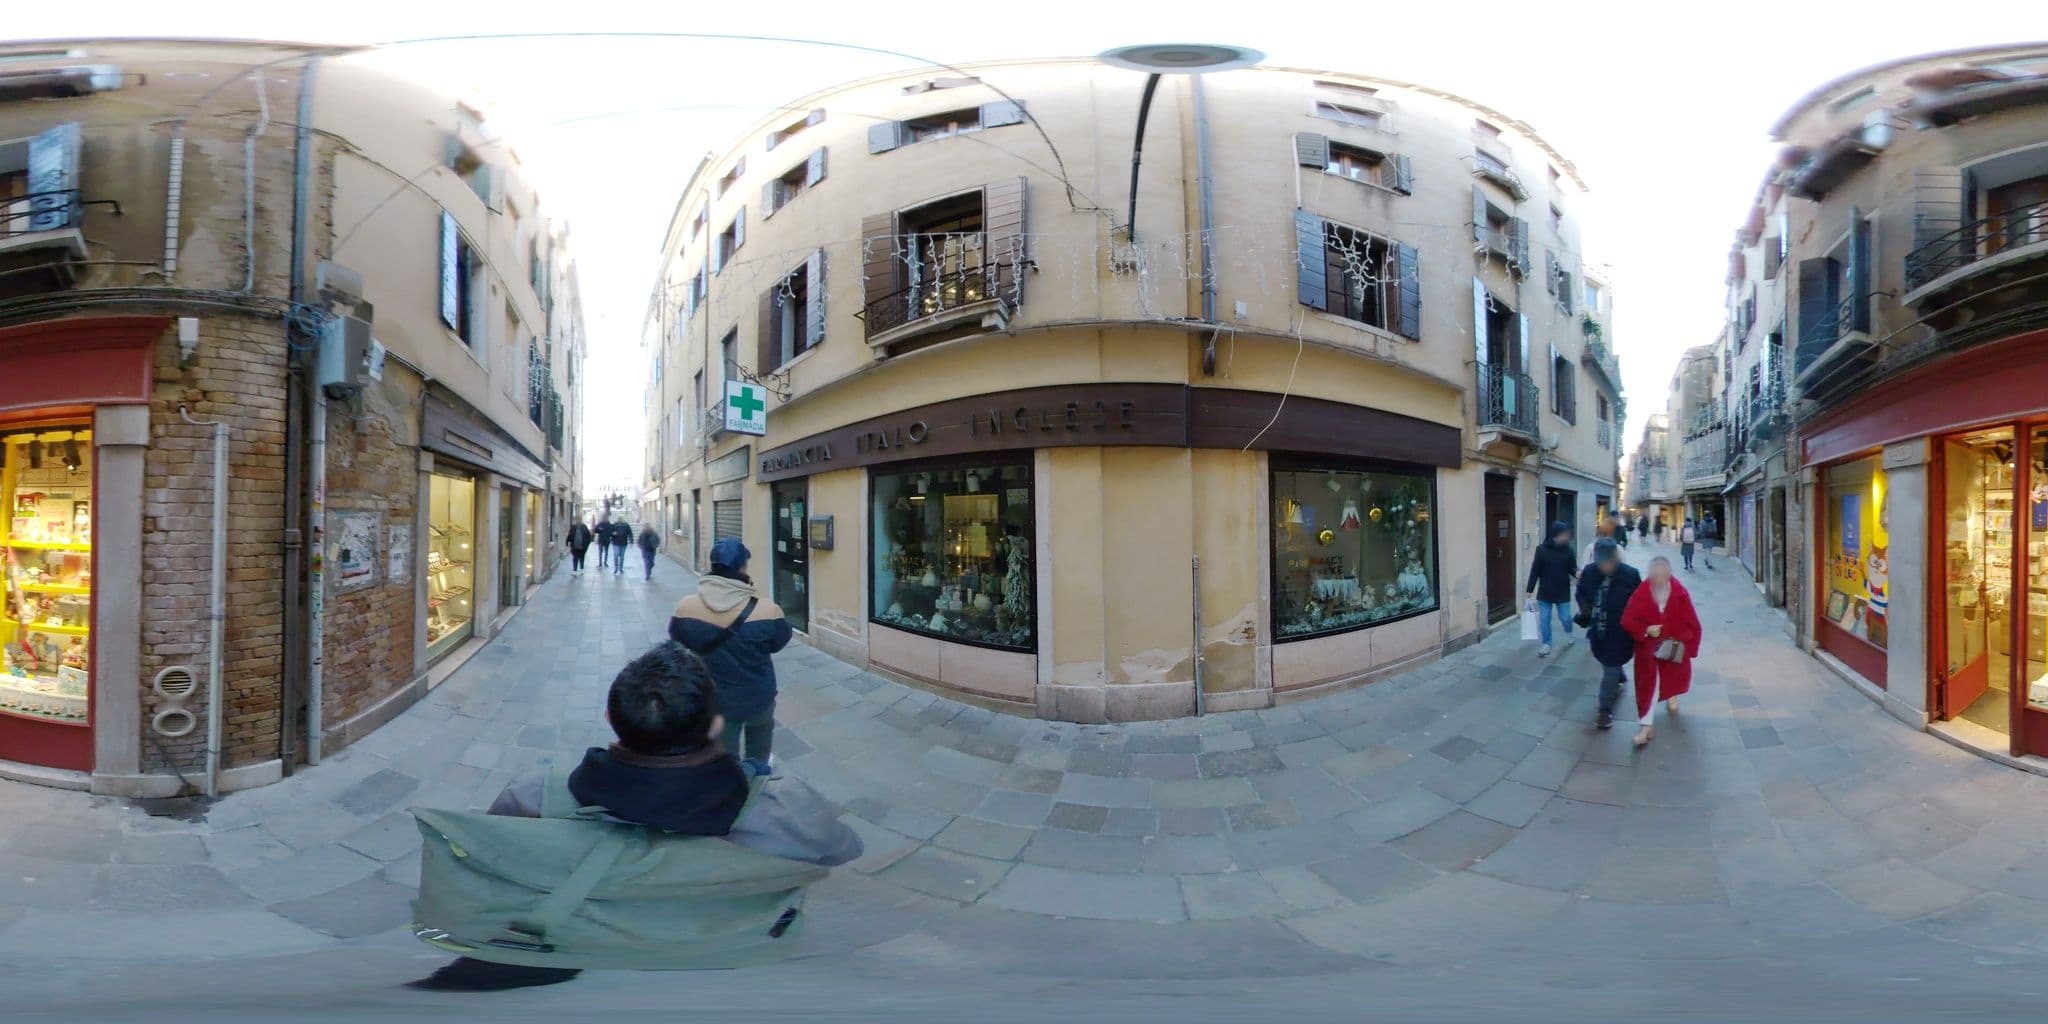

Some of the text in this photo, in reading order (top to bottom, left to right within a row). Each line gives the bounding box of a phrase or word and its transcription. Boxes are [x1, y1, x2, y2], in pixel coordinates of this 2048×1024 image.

[729, 419, 764, 431] FARMACIA
[762, 442, 833, 474] FARMACIA
[856, 419, 929, 454] ITALO
